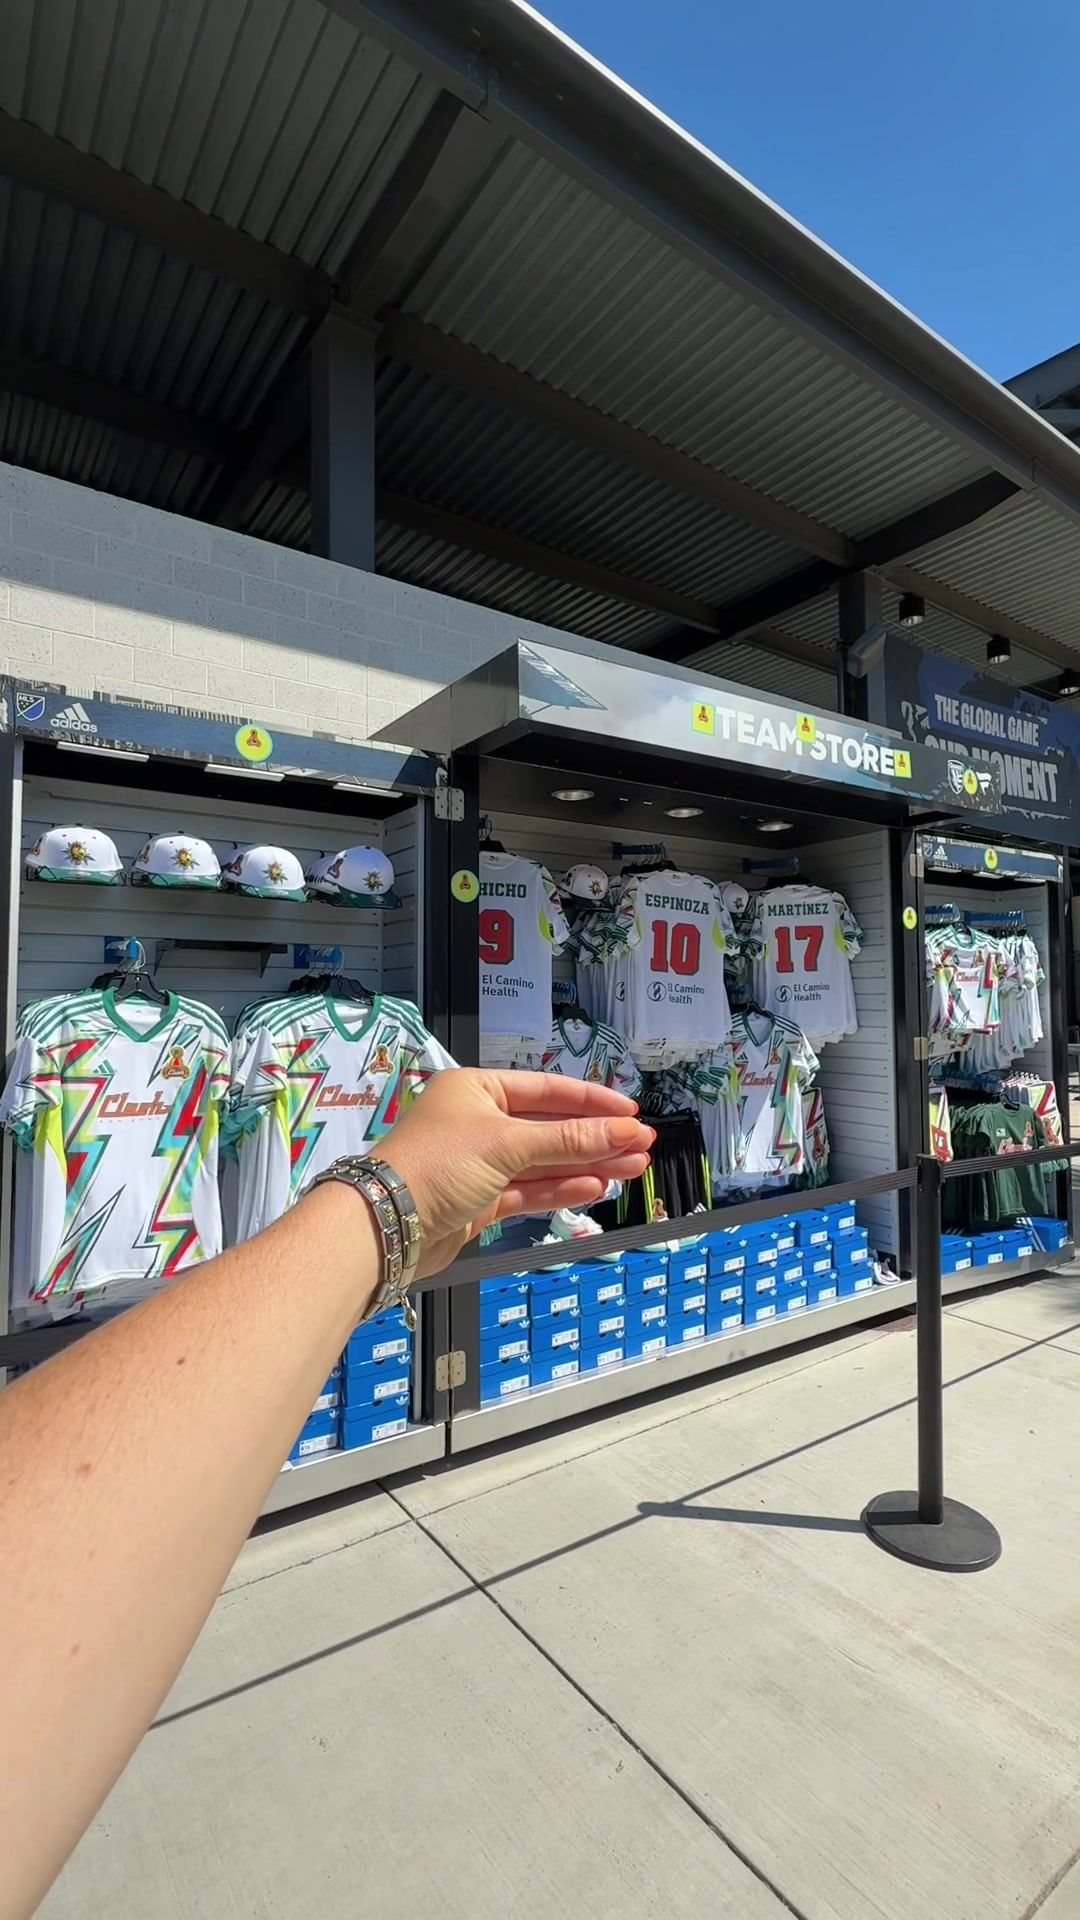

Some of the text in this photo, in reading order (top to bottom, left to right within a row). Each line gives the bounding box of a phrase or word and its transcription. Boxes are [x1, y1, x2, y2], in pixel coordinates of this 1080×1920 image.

[50, 719, 98, 732] adidas
[934, 694, 959, 727] THE
[960, 702, 1006, 739] GLOBAL
[1007, 716, 1040, 747] GAME
[716, 705, 804, 756] TEAM
[810, 732, 895, 776] STORE
[645, 894, 710, 915] ESPINOZA
[479, 909, 515, 966] 9
[650, 920, 701, 977] 10
[774, 925, 824, 973] 17
[482, 974, 534, 990] El Camino
[482, 986, 519, 998] Health
[793, 983, 830, 992] El Camino
[794, 993, 821, 1002] Health
